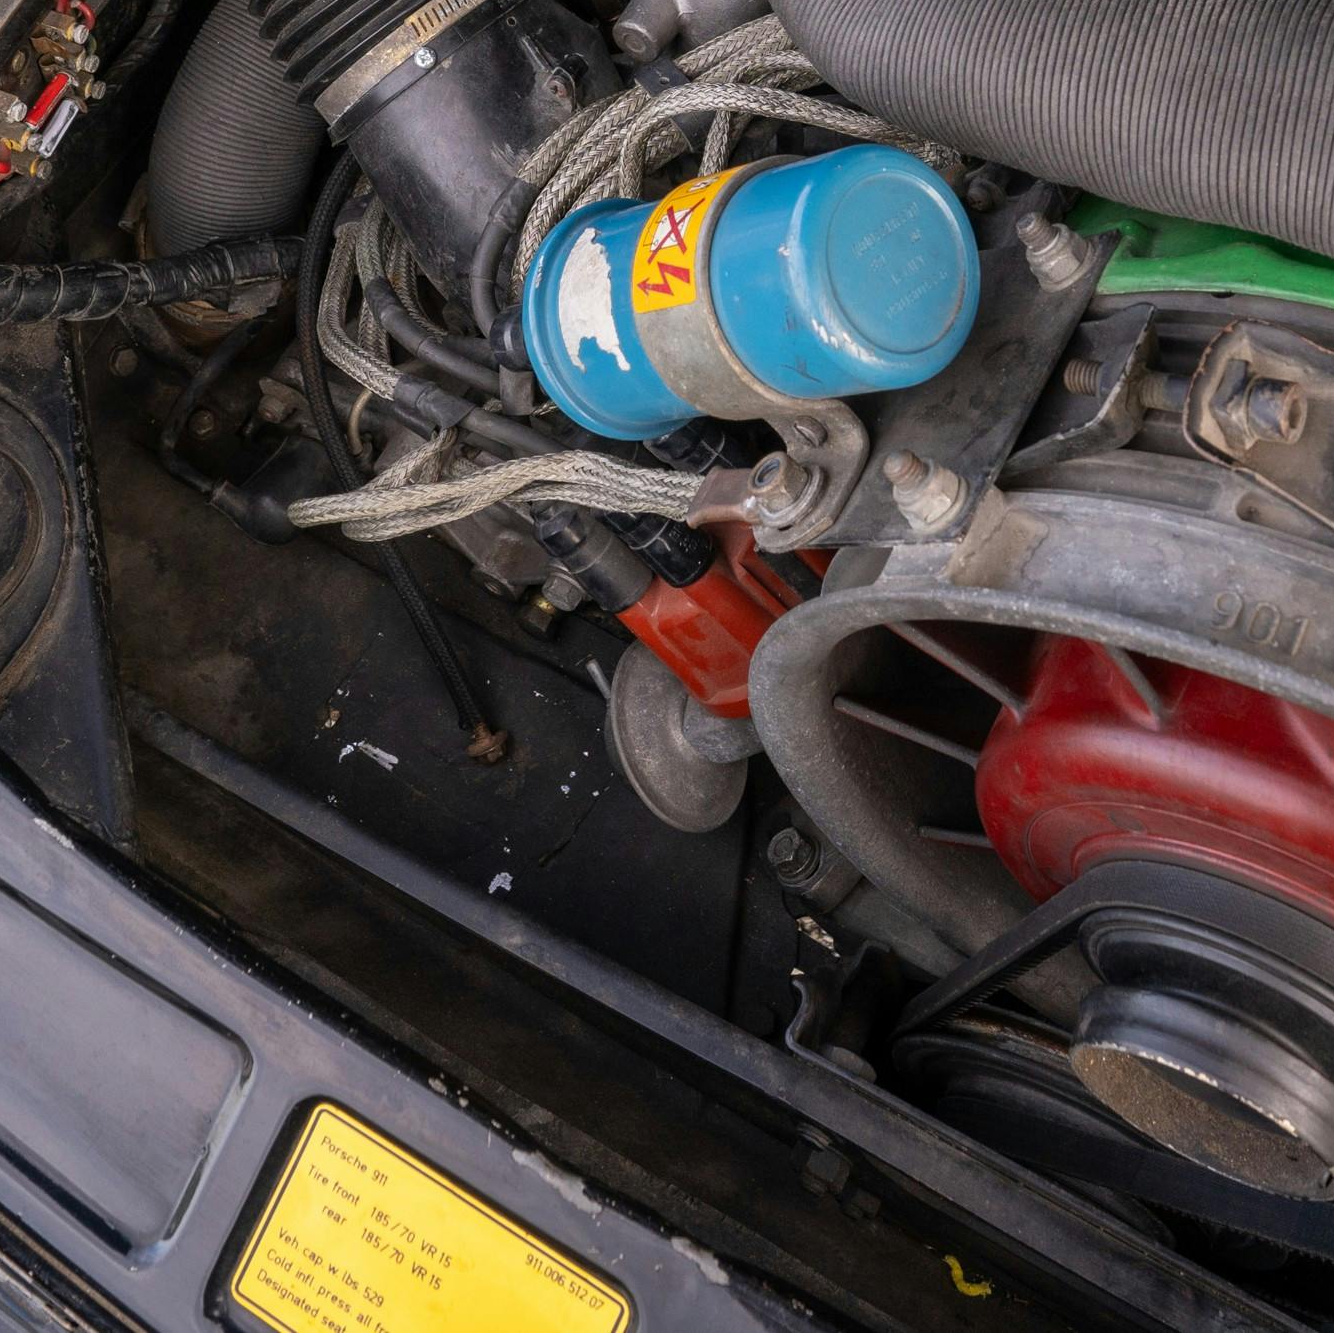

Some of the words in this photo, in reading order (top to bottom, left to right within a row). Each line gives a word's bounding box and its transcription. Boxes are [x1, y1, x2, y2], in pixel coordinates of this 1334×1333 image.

[1210, 590, 1313, 658] 901
[321, 1134, 368, 1174] Porsche
[371, 1168, 389, 1187] 911
[307, 1164, 330, 1186] Tire
[331, 1180, 361, 1207] front
[419, 1238, 438, 1259] VR
[439, 1252, 453, 1269] 15
[322, 1204, 348, 1227] rear
[410, 1261, 428, 1282] VR
[429, 1273, 443, 1292] 15
[256, 1267, 320, 1318] Designated
[266, 1247, 293, 1272] Cold
[356, 1312, 373, 1328] all
[362, 1286, 385, 1308] 529
